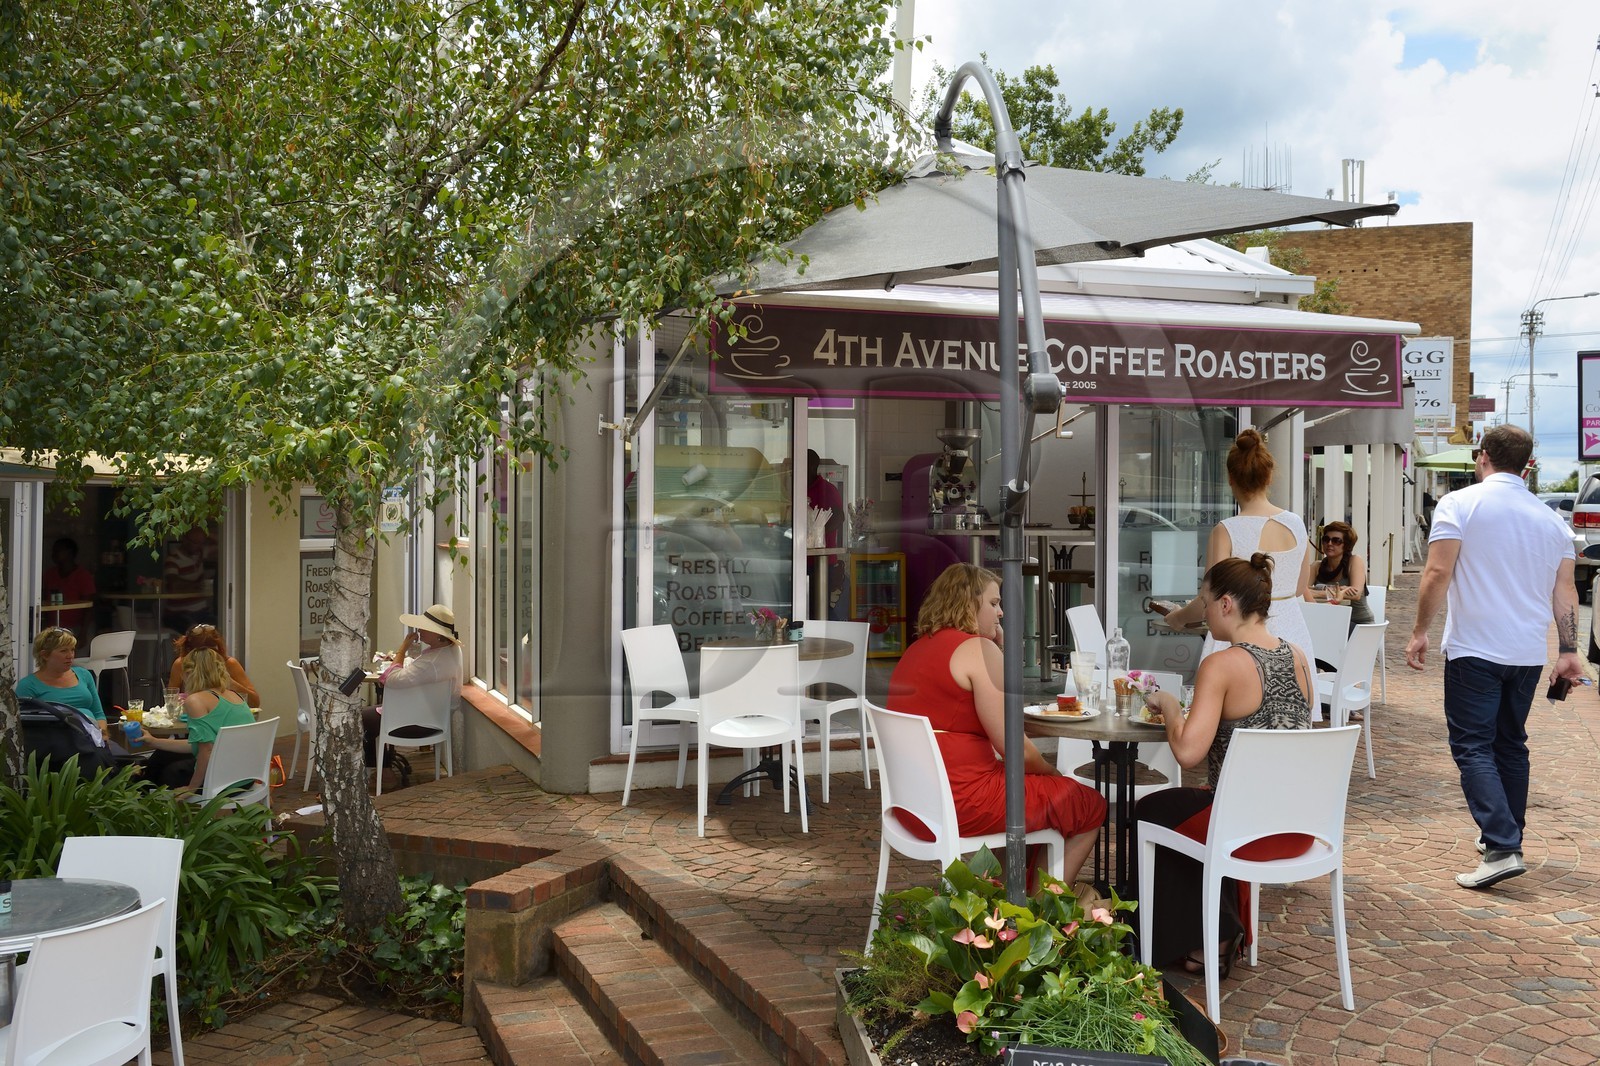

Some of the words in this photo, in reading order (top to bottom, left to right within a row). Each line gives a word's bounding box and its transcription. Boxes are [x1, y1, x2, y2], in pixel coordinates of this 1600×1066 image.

[813, 328, 883, 367] 4TH
[1045, 337, 1166, 378] COFFEE
[1175, 343, 1326, 382] ROASTERS
[1072, 381, 1097, 389] 2005
[668, 554, 750, 575] FRESHLY
[666, 580, 752, 601] ROASTED
[671, 606, 746, 627] COFFEE
